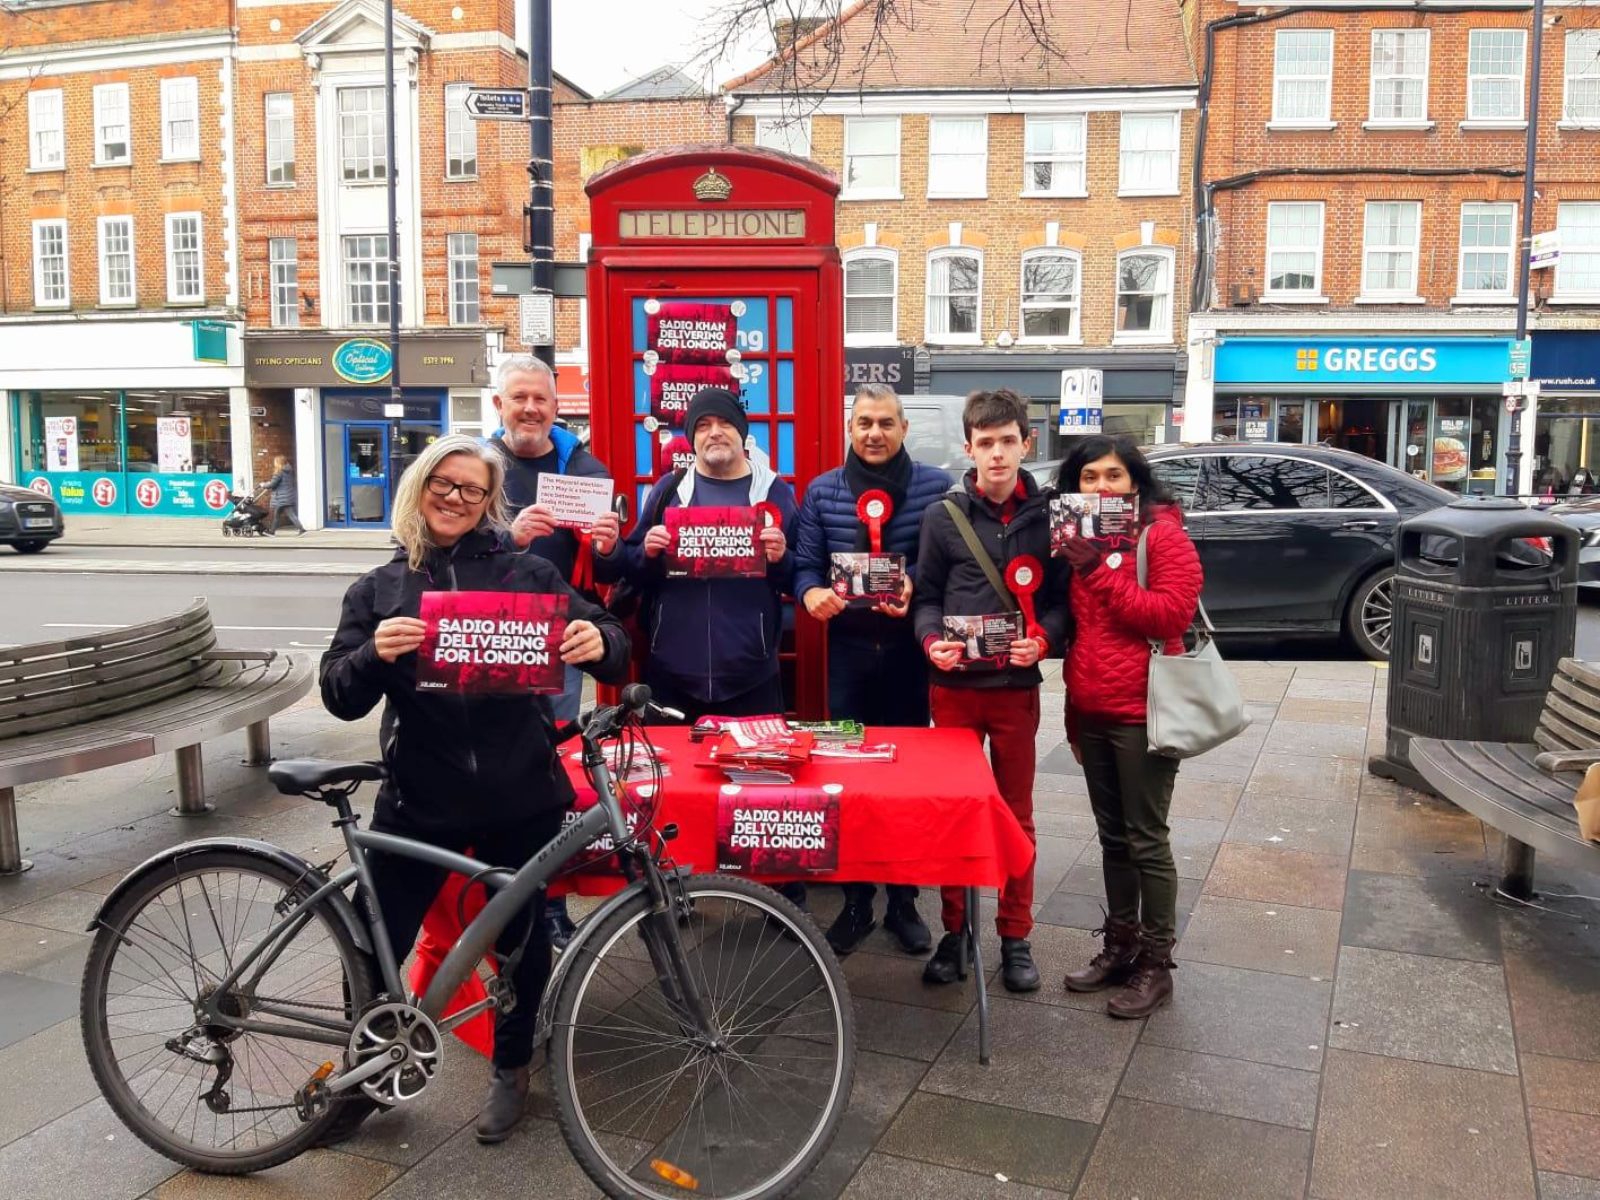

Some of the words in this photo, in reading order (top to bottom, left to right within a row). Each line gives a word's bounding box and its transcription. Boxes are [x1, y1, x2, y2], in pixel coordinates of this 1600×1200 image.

[629, 212, 798, 236] TELEPHONE
[659, 320, 693, 330] SADIQ
[695, 321, 726, 331] KHAN
[660, 329, 724, 341] DELIVERING
[657, 338, 679, 348] FOR
[681, 340, 726, 350] LONDON
[255, 357, 282, 365] STYLING
[284, 357, 322, 365] OPTICIANS
[345, 353, 378, 364] Optical
[1324, 347, 1437, 372] GREGGS
[662, 382, 697, 392] SADIQ
[698, 383, 729, 391] KN
[663, 391, 696, 401] DELIV
[660, 400, 682, 410] FOR
[60, 486, 85, 497] Value
[679, 526, 717, 537] SADIQ
[719, 526, 753, 537] KHAN
[679, 536, 752, 547] DELIVERING
[677, 547, 702, 558] FOR
[703, 547, 755, 557] LONDON
[1408, 588, 1444, 603] LITTER
[1506, 595, 1550, 606] LITTER
[438, 618, 495, 634] SADIQ
[499, 621, 549, 636] KHAN
[439, 633, 546, 651] DELIVERING
[435, 648, 471, 664] FOR
[474, 649, 549, 666] LONDON
[733, 809, 780, 823] SADIQ
[782, 810, 825, 823] KHAN
[734, 822, 822, 836] DELIVERING
[730, 835, 760, 848] FOR
[762, 836, 825, 849] LONDON
